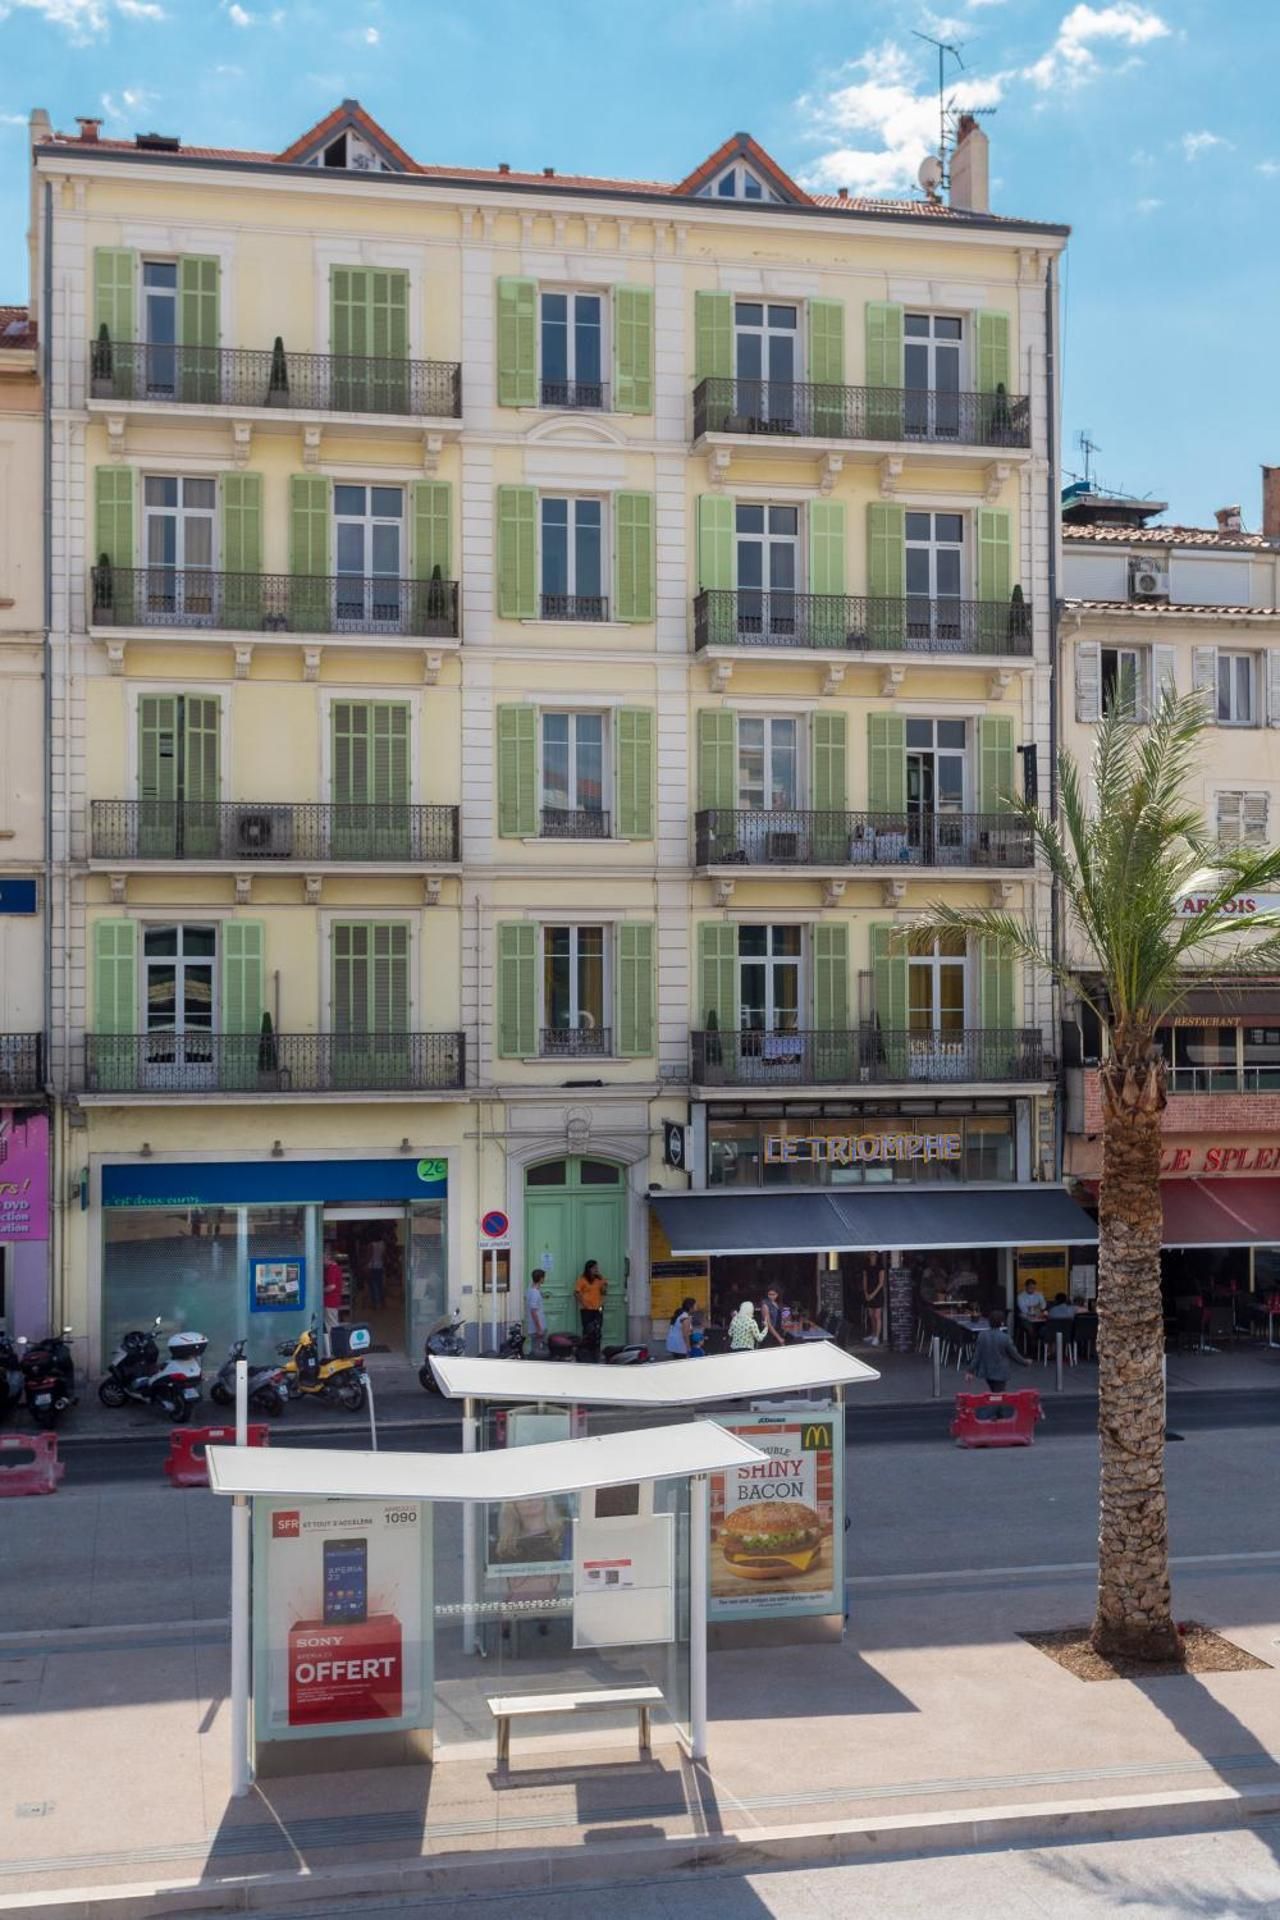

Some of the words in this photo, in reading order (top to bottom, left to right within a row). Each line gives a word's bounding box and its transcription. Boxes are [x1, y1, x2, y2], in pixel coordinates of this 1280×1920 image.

[1174, 1017, 1240, 1027] RESTAURANT
[763, 1135, 798, 1163] LE
[806, 1133, 961, 1165] TRIOMPHE
[737, 1459, 804, 1480] SHINY
[738, 1481, 805, 1500] BACON
[277, 1518, 299, 1531] SFR
[296, 1636, 344, 1648] SONY
[295, 1657, 396, 1684] OFFERT
